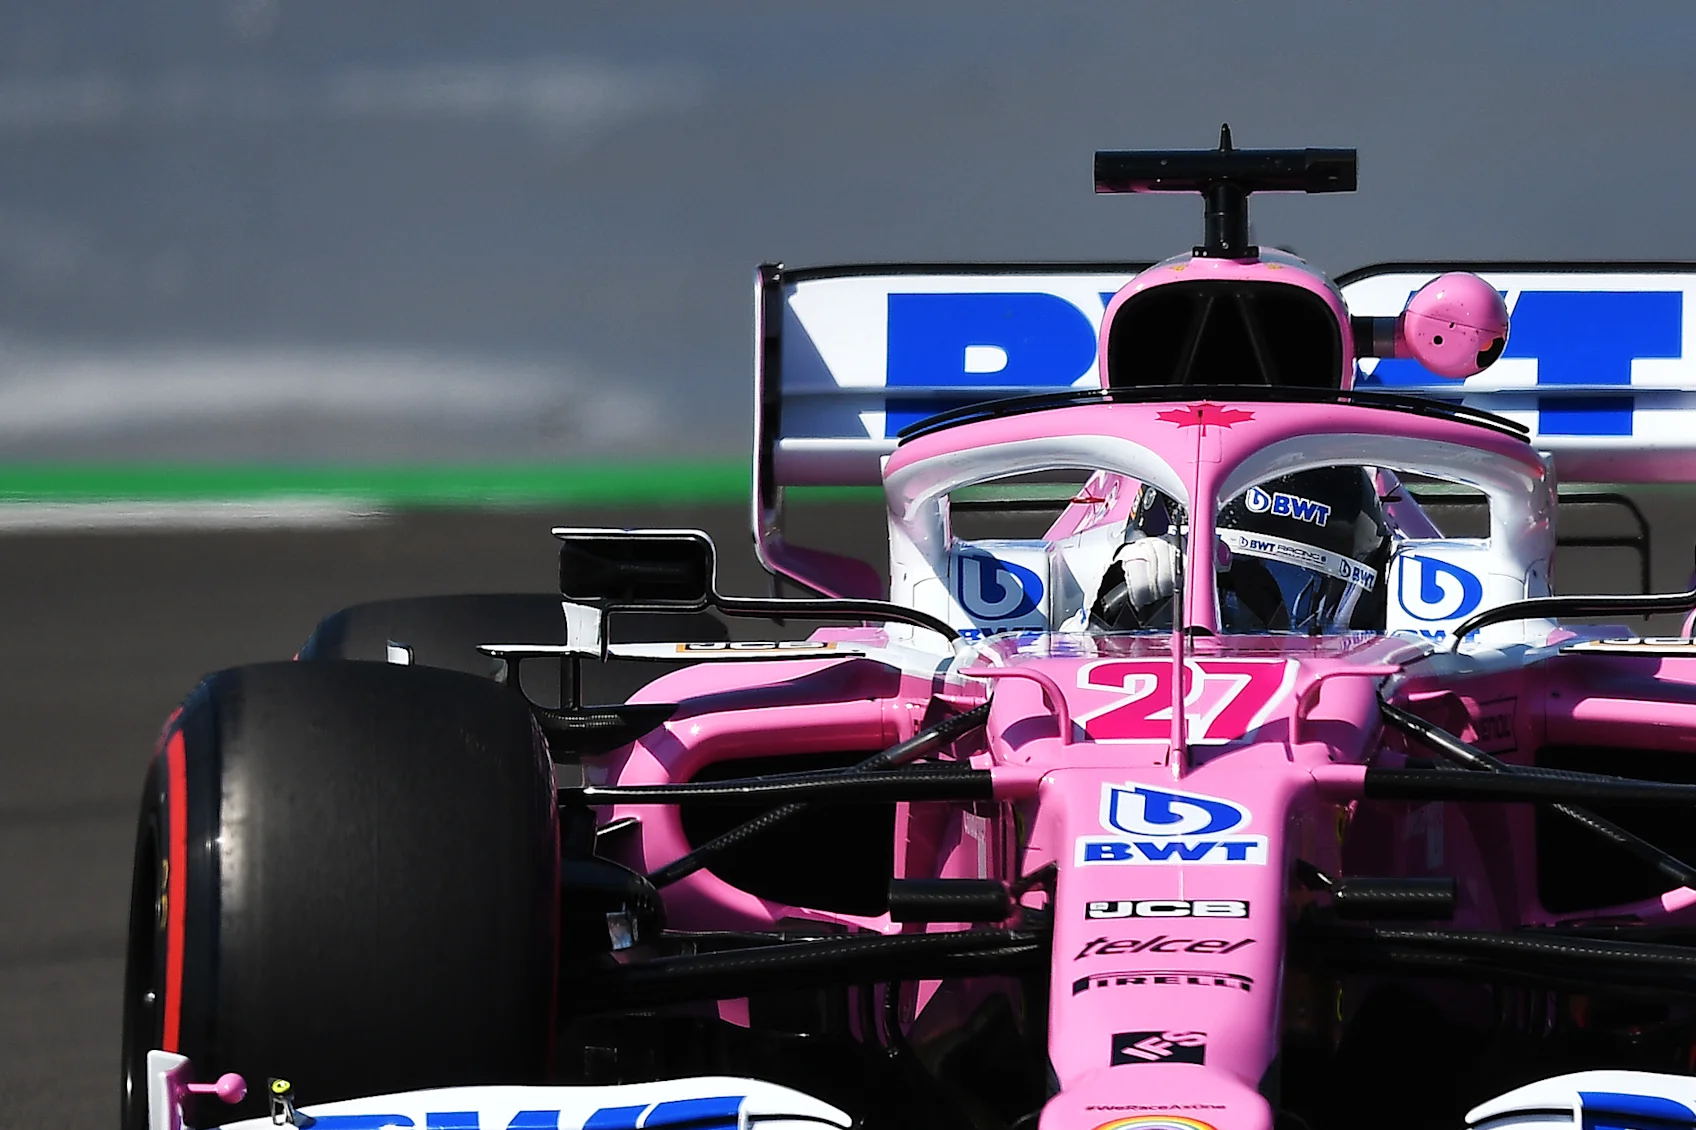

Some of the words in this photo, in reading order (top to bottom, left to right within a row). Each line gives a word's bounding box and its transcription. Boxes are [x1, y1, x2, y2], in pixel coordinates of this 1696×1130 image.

[1272, 493, 1331, 527] BWT
[1249, 539, 1276, 553] BWT
[1352, 567, 1375, 590] BWT
[1077, 659, 1299, 745] 27
[1084, 841, 1258, 862] BWT
[1088, 901, 1247, 918] JCB
[1073, 935, 1257, 960] telcel
[1072, 969, 1254, 997] PIRELLI
[1120, 1030, 1208, 1062] IFS
[1084, 1104, 1227, 1112] #WeRaceAsOne
